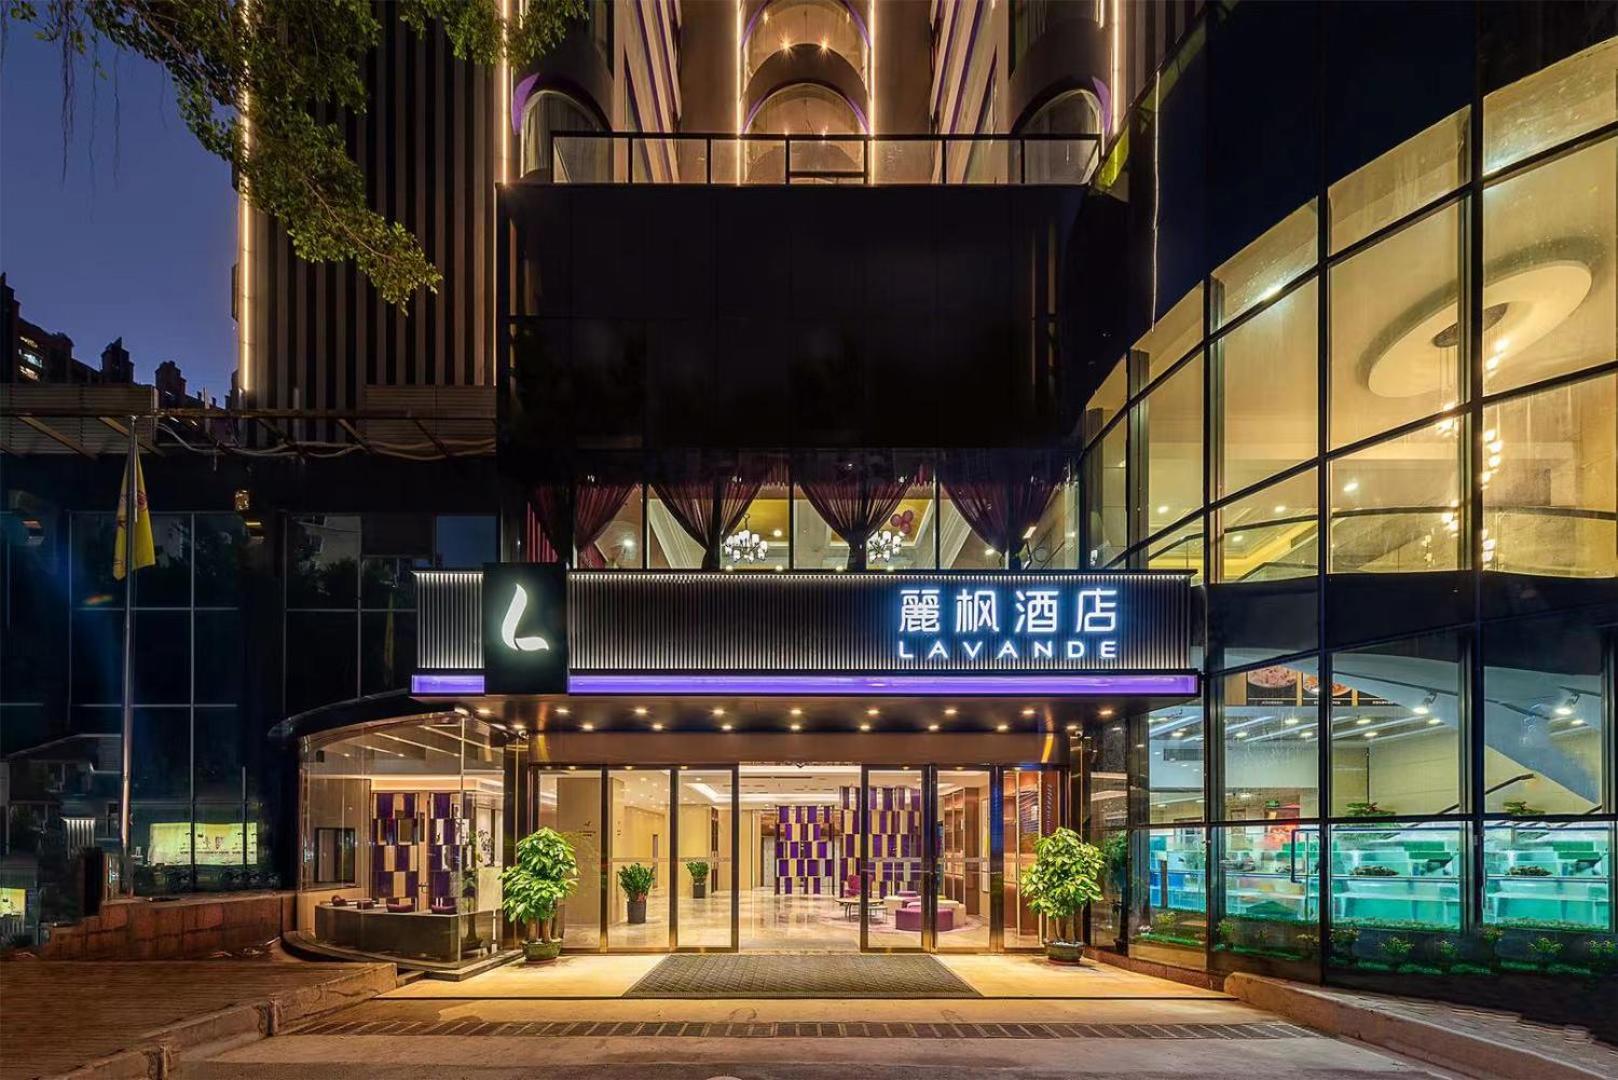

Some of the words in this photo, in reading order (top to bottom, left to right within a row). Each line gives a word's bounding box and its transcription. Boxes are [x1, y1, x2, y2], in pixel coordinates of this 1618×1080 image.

[899, 588, 1117, 633] 麗枫酒店
[899, 641, 1118, 659] LAVANDE
